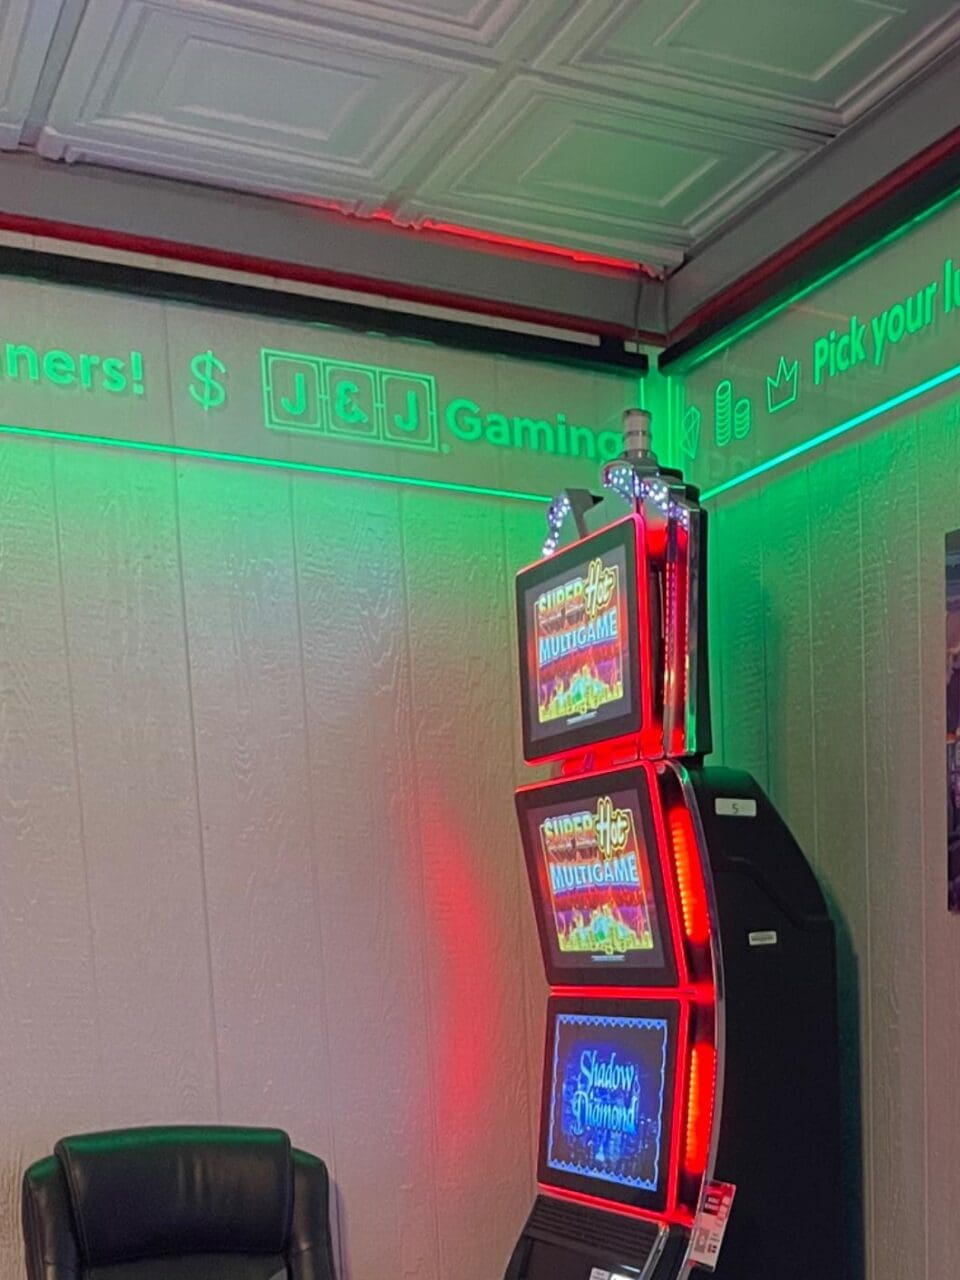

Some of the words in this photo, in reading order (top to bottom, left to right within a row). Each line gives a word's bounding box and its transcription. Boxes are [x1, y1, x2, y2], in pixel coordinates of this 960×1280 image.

[812, 315, 867, 386] Pick
[871, 281, 938, 366] your
[4, 339, 145, 396] ners!
[444, 397, 625, 461] Gaming
[583, 557, 618, 620] Hot
[538, 606, 619, 668] MULTIGAME
[594, 796, 629, 859] Hot
[549, 853, 640, 892] MULTIGAME
[579, 1049, 635, 1093] Shadow
[571, 1089, 640, 1136] Diamond
